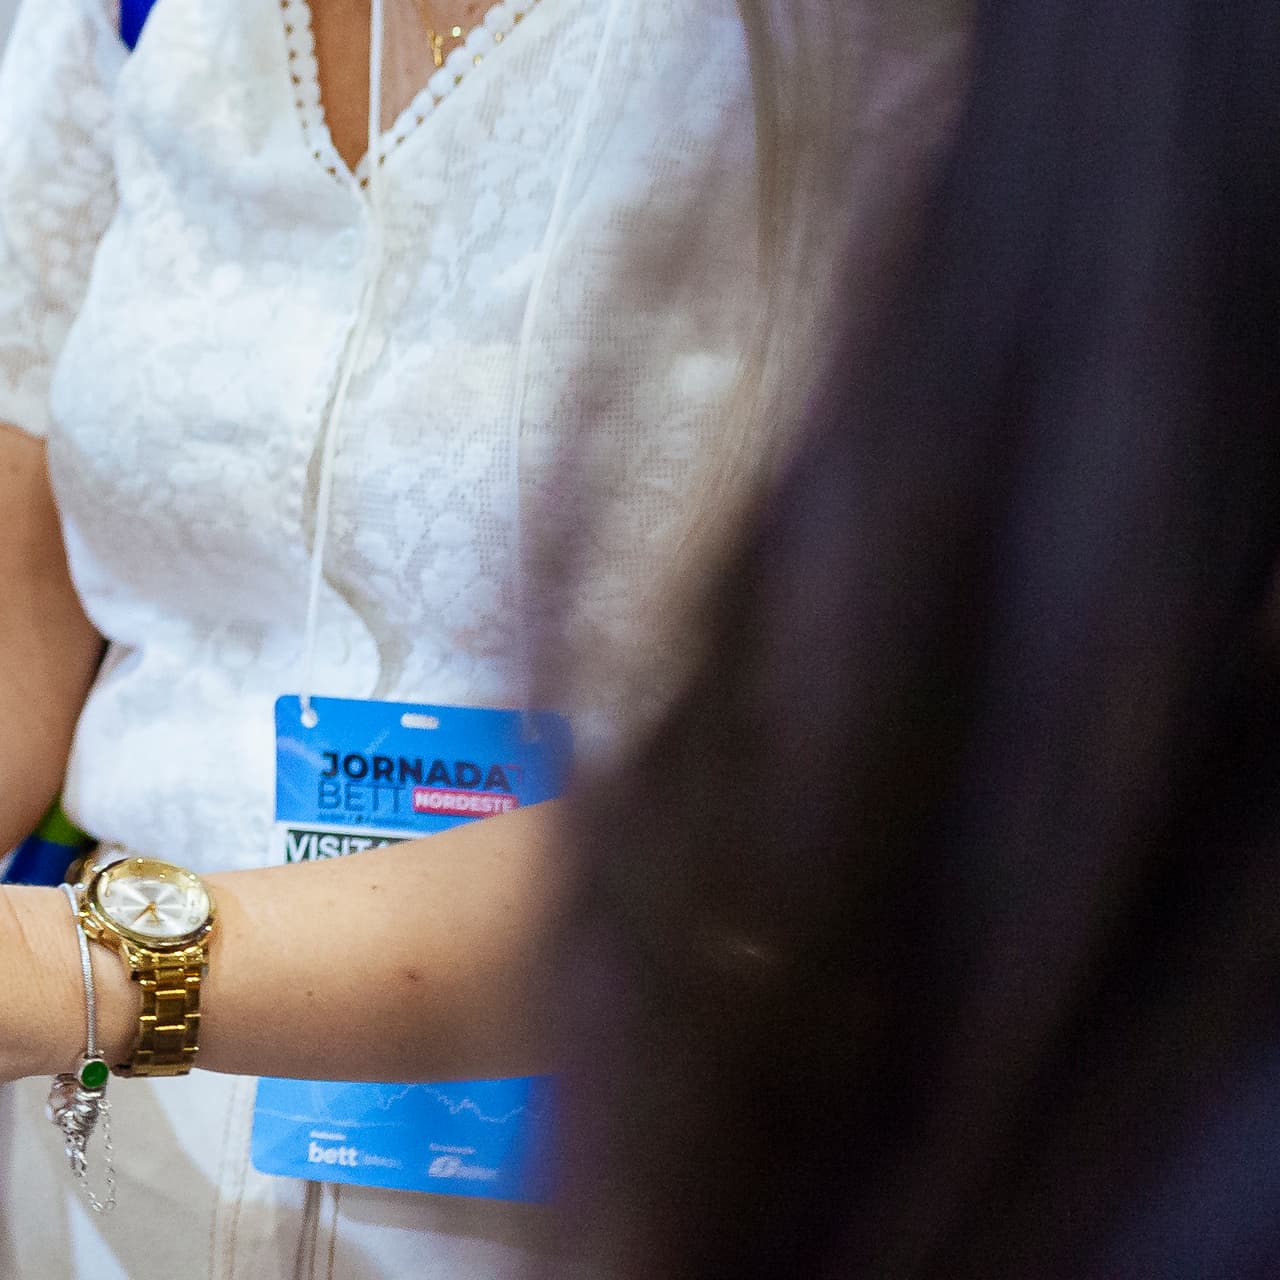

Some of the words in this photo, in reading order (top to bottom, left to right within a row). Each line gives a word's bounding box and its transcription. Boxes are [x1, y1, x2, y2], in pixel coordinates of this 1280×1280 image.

[322, 751, 512, 792] JORNADA
[317, 780, 407, 813] BETT
[307, 1141, 358, 1167] bett
